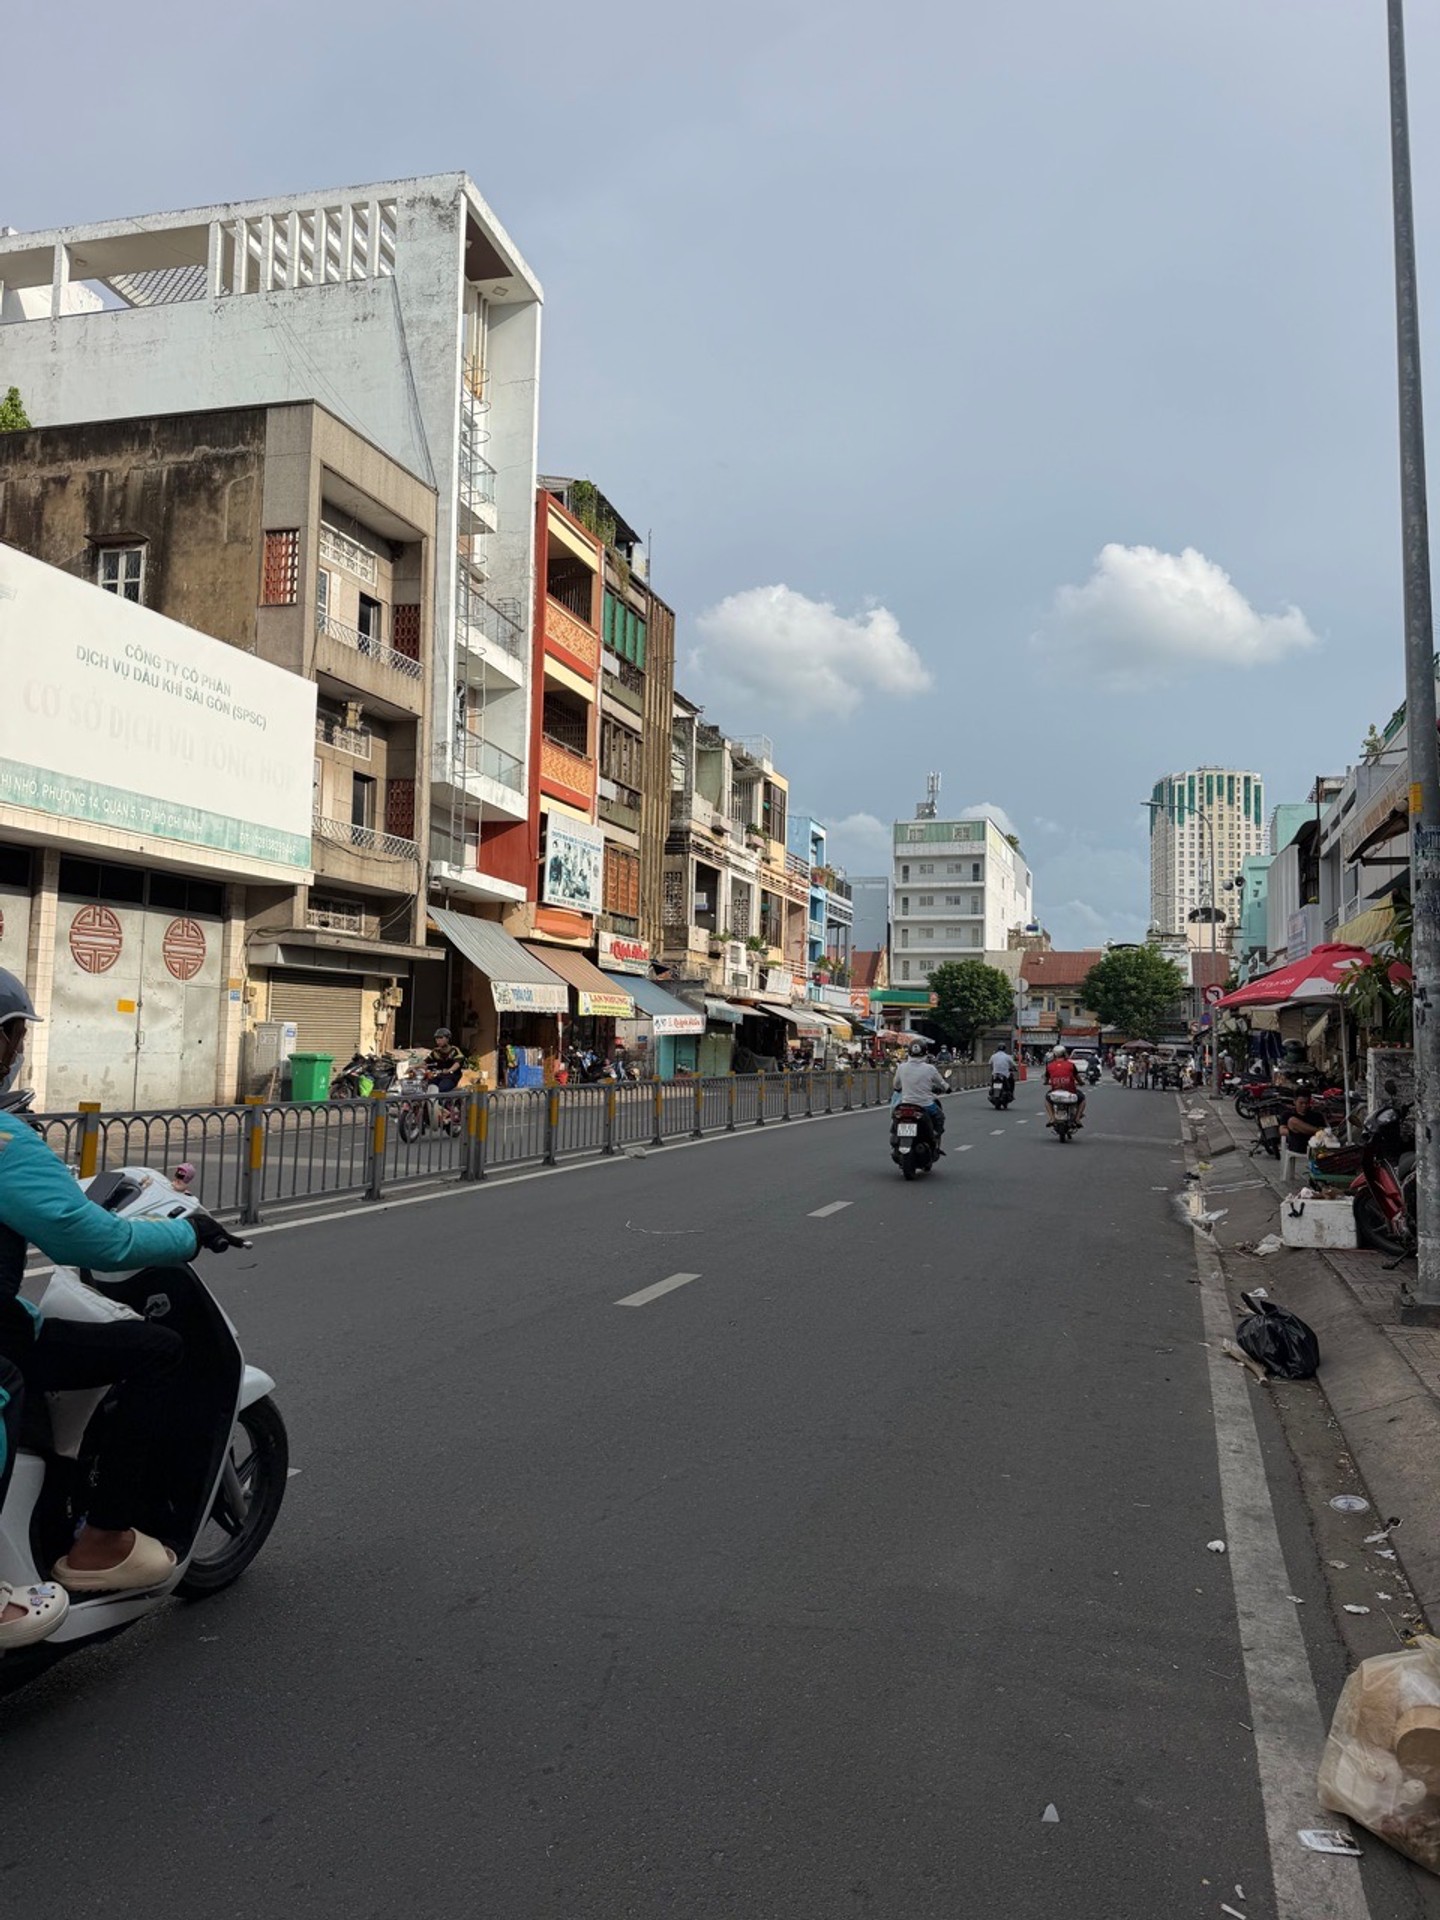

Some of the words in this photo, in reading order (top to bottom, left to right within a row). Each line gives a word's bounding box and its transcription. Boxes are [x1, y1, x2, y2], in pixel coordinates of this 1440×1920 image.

[76, 645, 109, 669] DỊCH
[112, 657, 130, 681] VỤ
[162, 678, 183, 698] KHÍ
[232, 704, 267, 731] (SPSC)
[125, 643, 161, 669] CÔNG
[165, 658, 179, 676] TY
